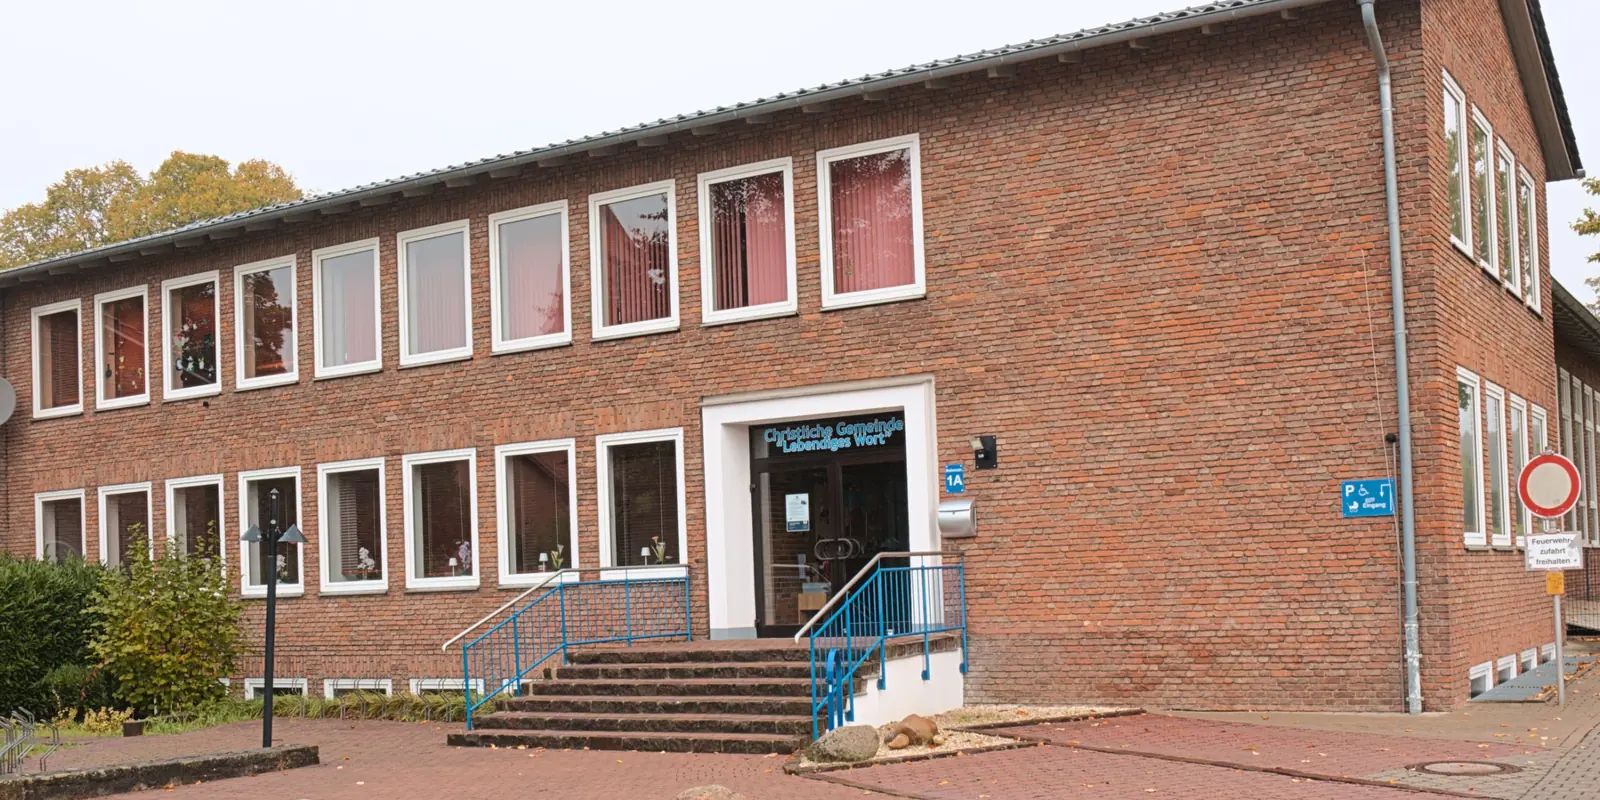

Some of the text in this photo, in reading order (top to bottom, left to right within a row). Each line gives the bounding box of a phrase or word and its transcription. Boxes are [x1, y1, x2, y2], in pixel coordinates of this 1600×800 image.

[764, 416, 904, 443] Christliche Gemeinde
[947, 474, 963, 487] 1A
[1345, 484, 1355, 497] P
[1540, 547, 1566, 555] zufahrt
[1535, 557, 1571, 565] freihalten
